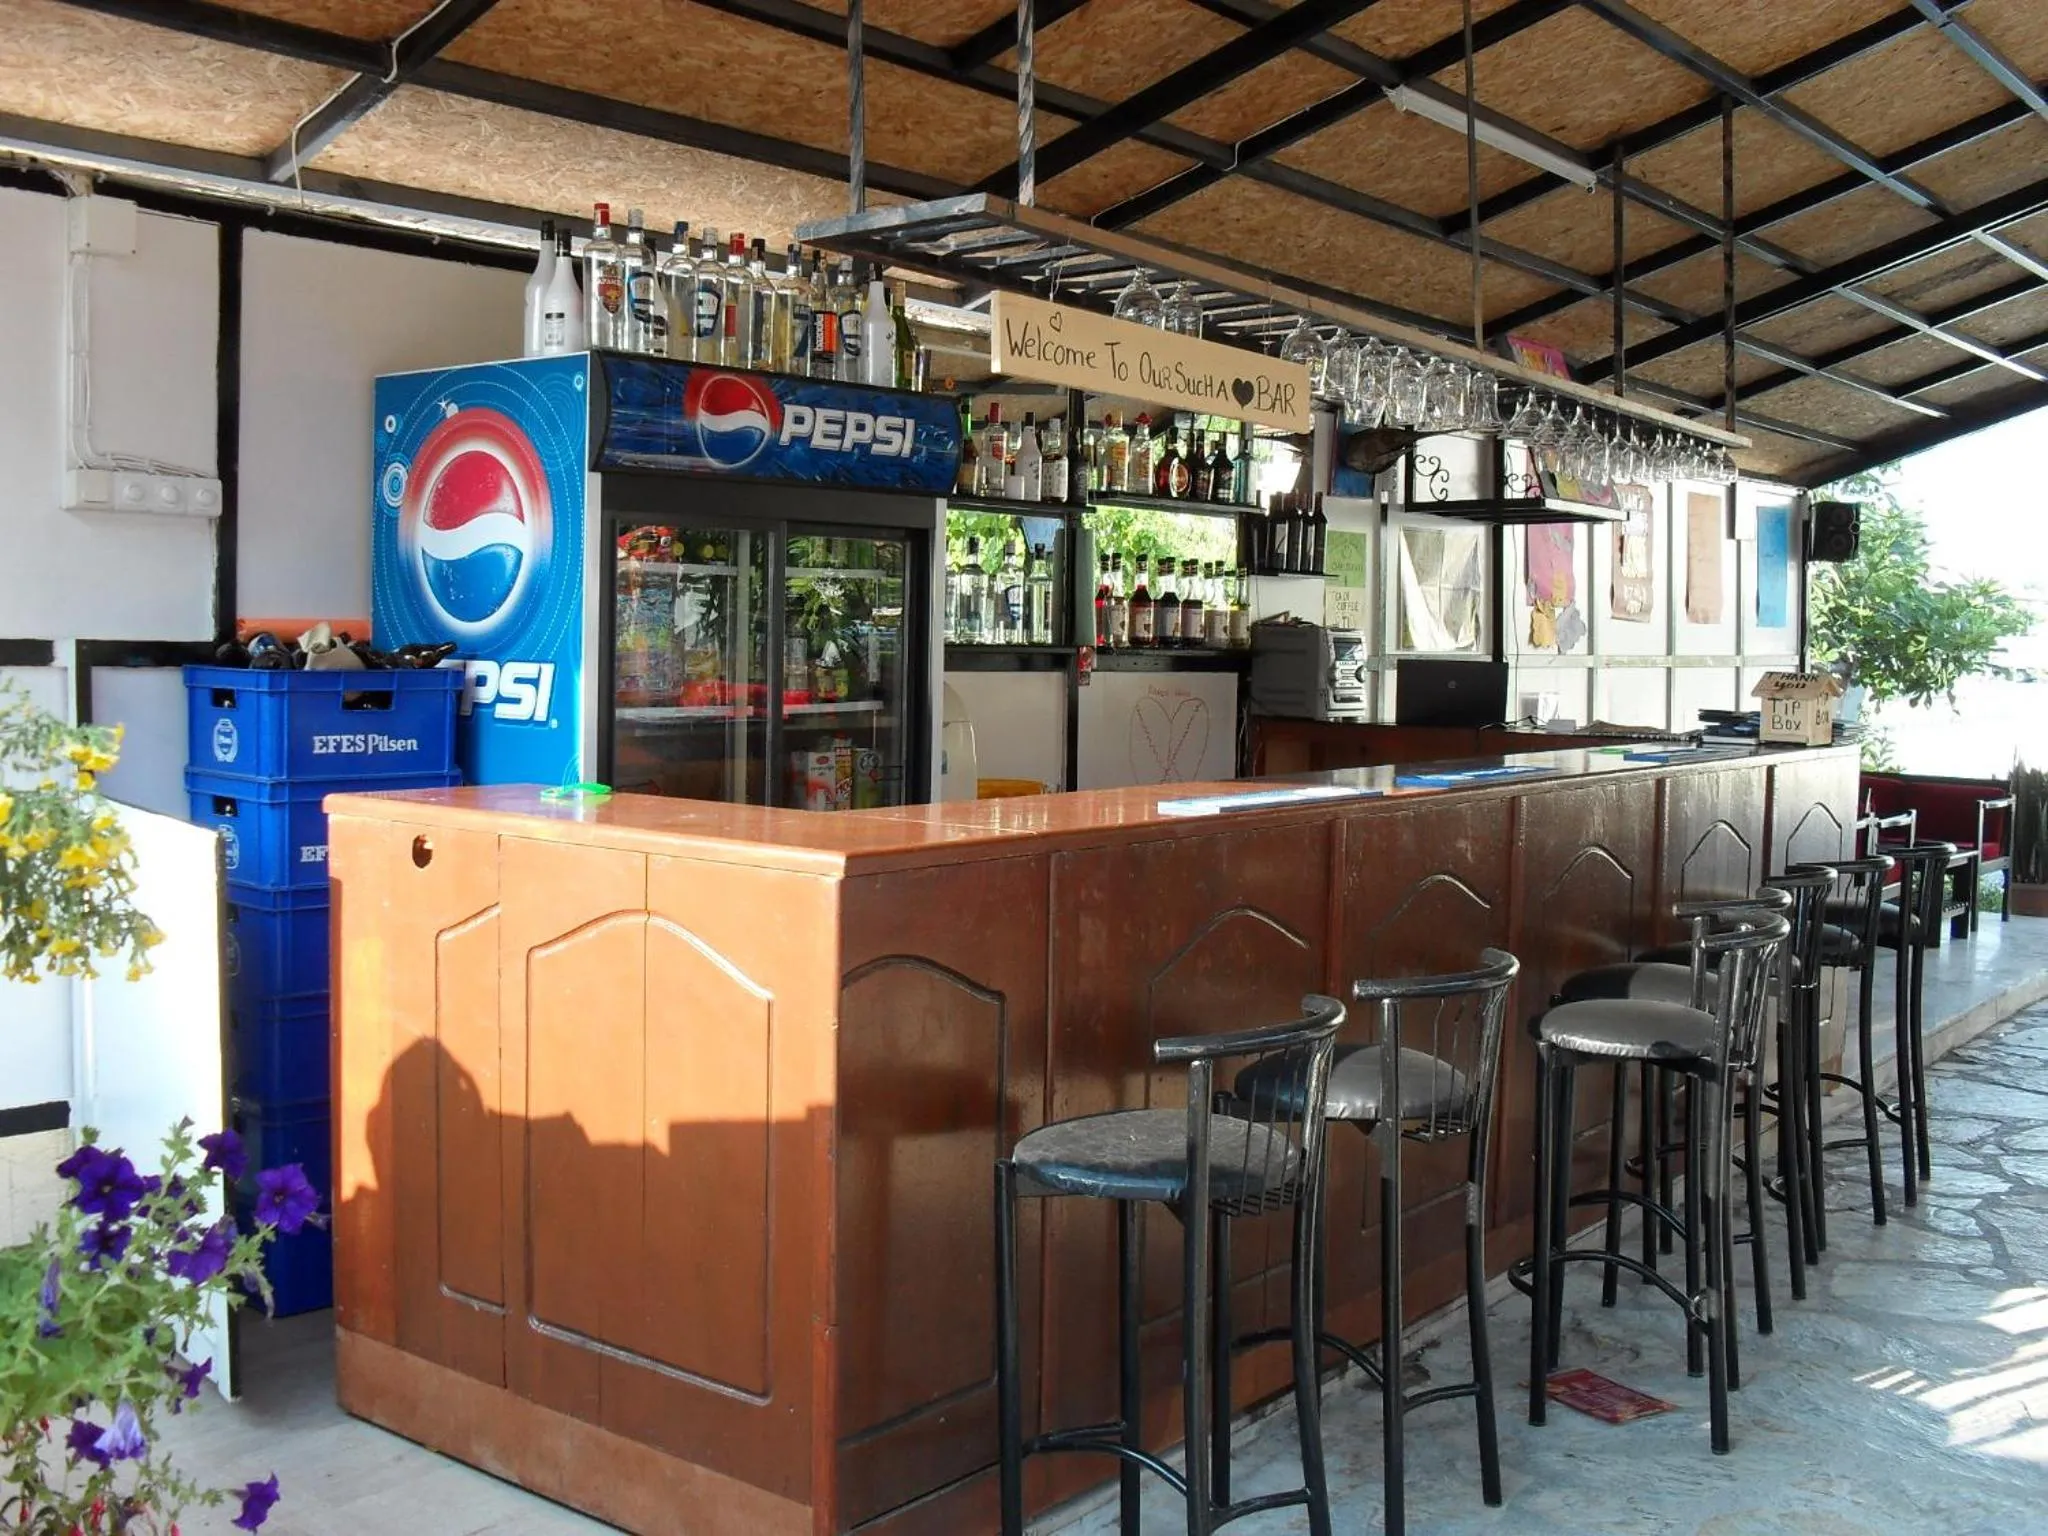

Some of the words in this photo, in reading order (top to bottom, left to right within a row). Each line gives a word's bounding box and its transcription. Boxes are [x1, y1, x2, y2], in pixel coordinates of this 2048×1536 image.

[1006, 317, 1098, 369] Welcome
[1104, 342, 1129, 382] To
[1254, 374, 1297, 417] BAR
[778, 403, 917, 459] PEPSI
[458, 660, 556, 722] PSI
[312, 734, 365, 754] EFES
[367, 733, 419, 755] Pilsen
[300, 845, 328, 862] EF
